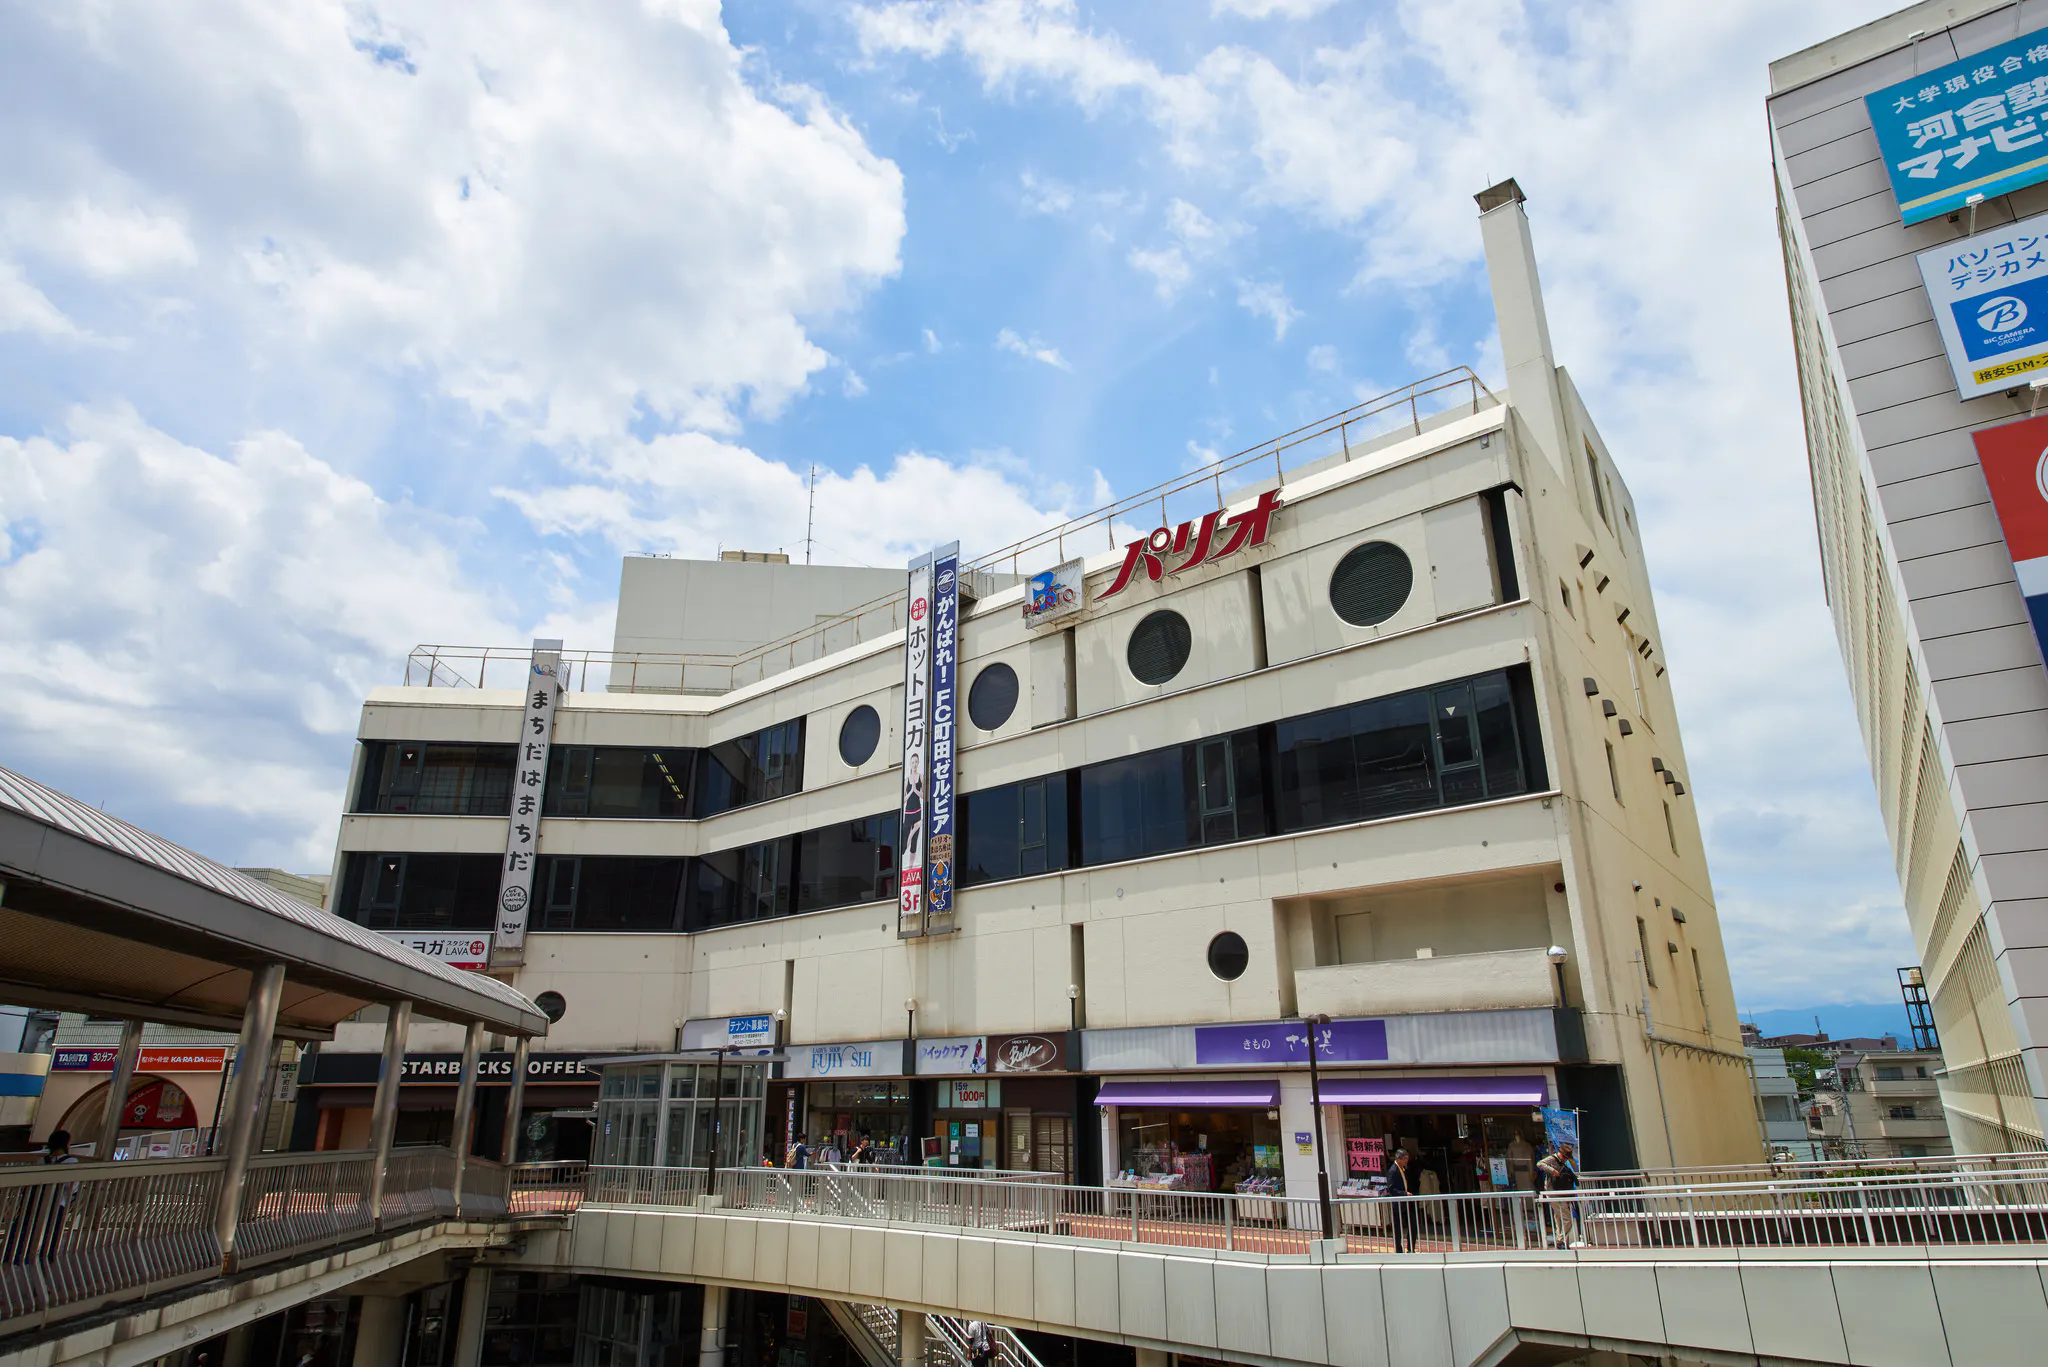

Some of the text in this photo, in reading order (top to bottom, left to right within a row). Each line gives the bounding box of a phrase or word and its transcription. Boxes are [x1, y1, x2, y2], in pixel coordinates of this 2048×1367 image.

[1906, 75, 2048, 149] 河合塾
[1897, 111, 2048, 179] マナビ
[1951, 251, 2046, 290] デジカメ
[1983, 326, 2036, 345] BIC CAMERA
[1997, 335, 2025, 347] GROUP
[1092, 487, 1284, 603] パリオ
[1022, 588, 1077, 618] PARIO
[907, 626, 926, 750] ホットヨガ
[509, 690, 548, 871] まちだはまちだ
[902, 871, 921, 883] LAVA
[902, 890, 920, 911] 3F
[445, 947, 469, 956] LAVA
[1243, 1038, 1271, 1050] きもの
[59, 1053, 88, 1062] TANITA
[1009, 1043, 1043, 1067] Bella
[400, 1061, 586, 1075] STARBCKS OFFEE
[955, 1082, 968, 1091] 15分
[959, 1090, 984, 1103] 1,000円
